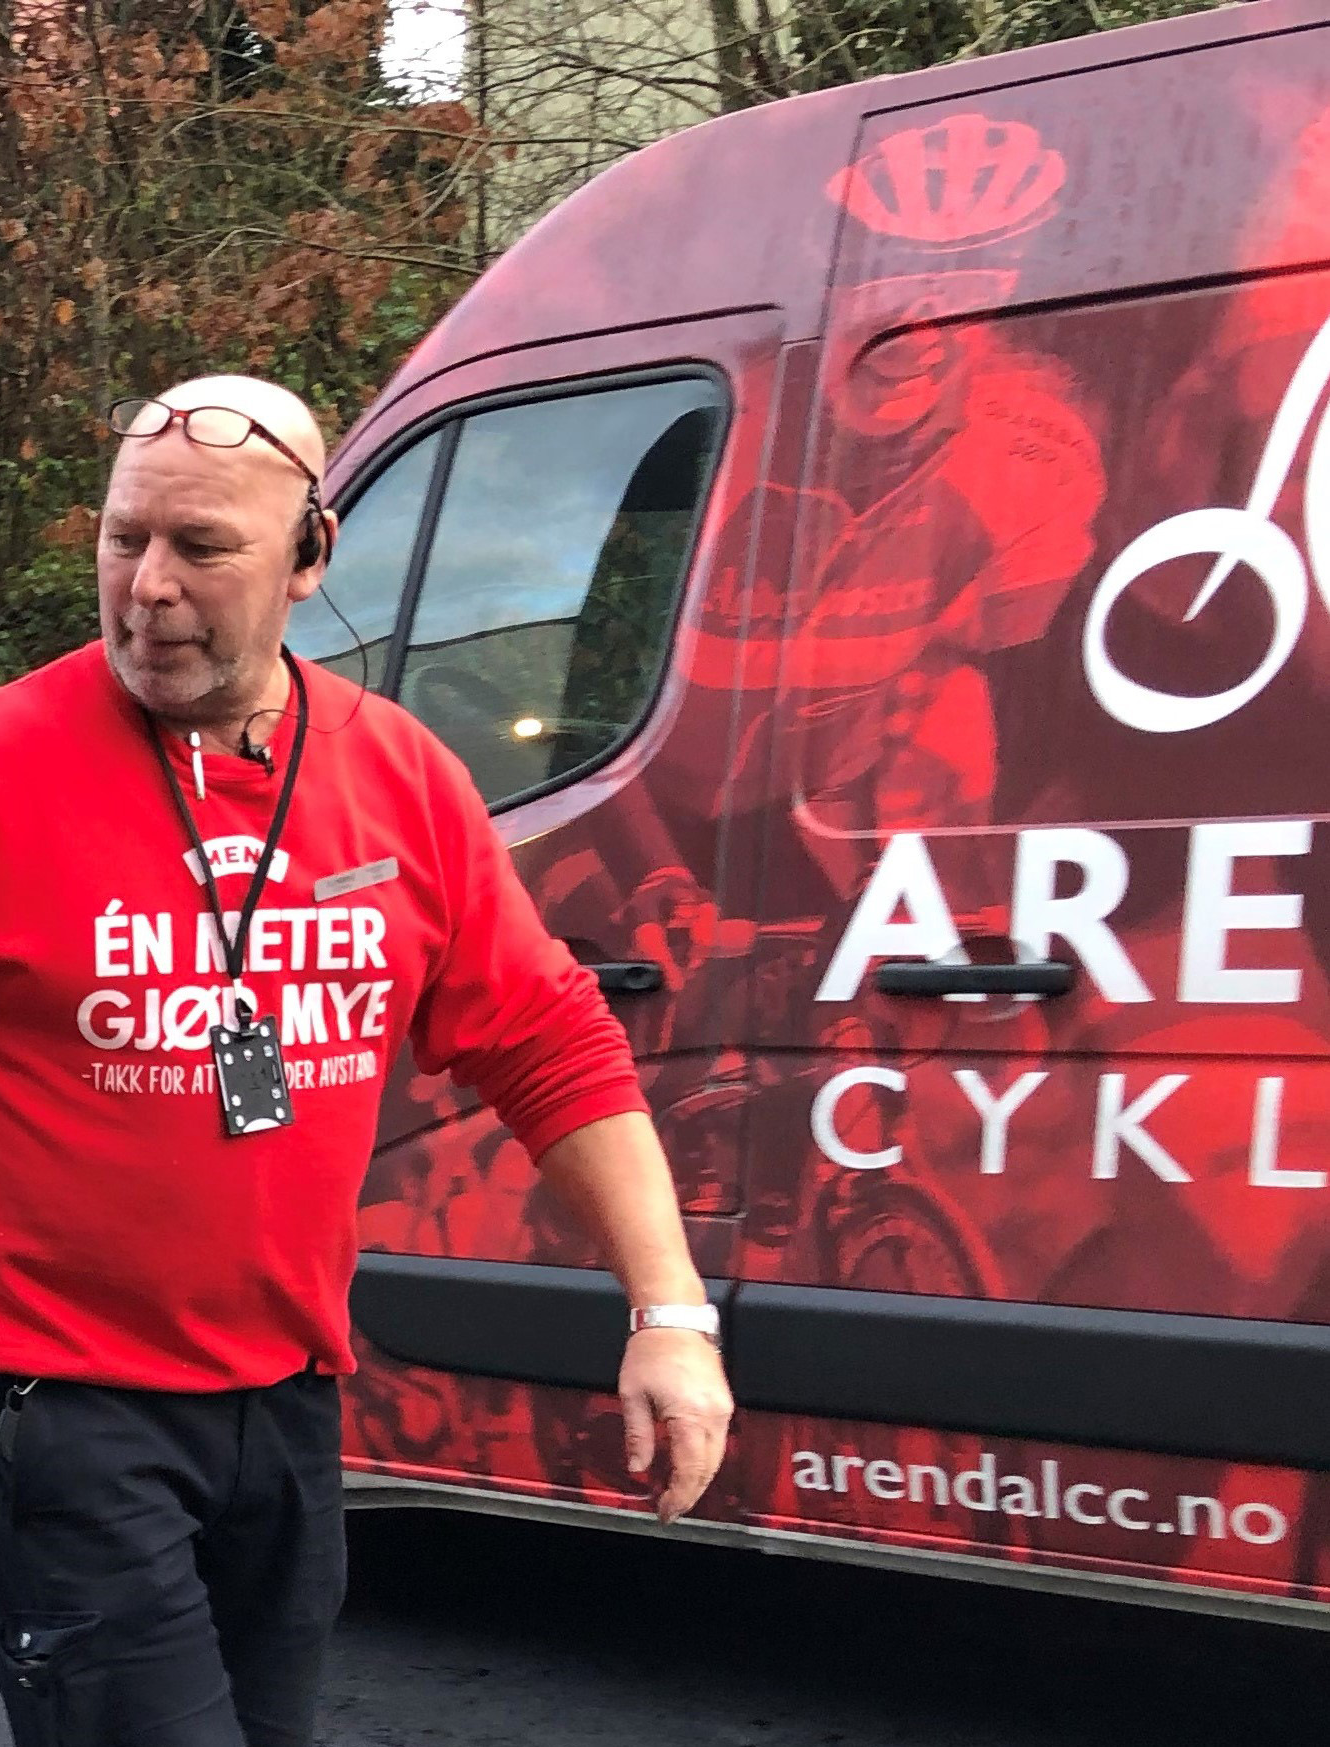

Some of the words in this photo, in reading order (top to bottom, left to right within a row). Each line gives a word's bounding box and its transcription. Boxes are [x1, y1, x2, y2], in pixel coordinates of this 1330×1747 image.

[207, 845, 276, 867] MEN
[95, 898, 173, 978] ÉN
[816, 820, 1313, 1003] ARE
[281, 979, 394, 1047] MYE
[82, 1062, 144, 1095] -TAKK
[148, 1063, 186, 1095] FOR
[811, 1066, 1330, 1188] CYKL
[791, 1449, 1289, 1546] arendalcc.no
